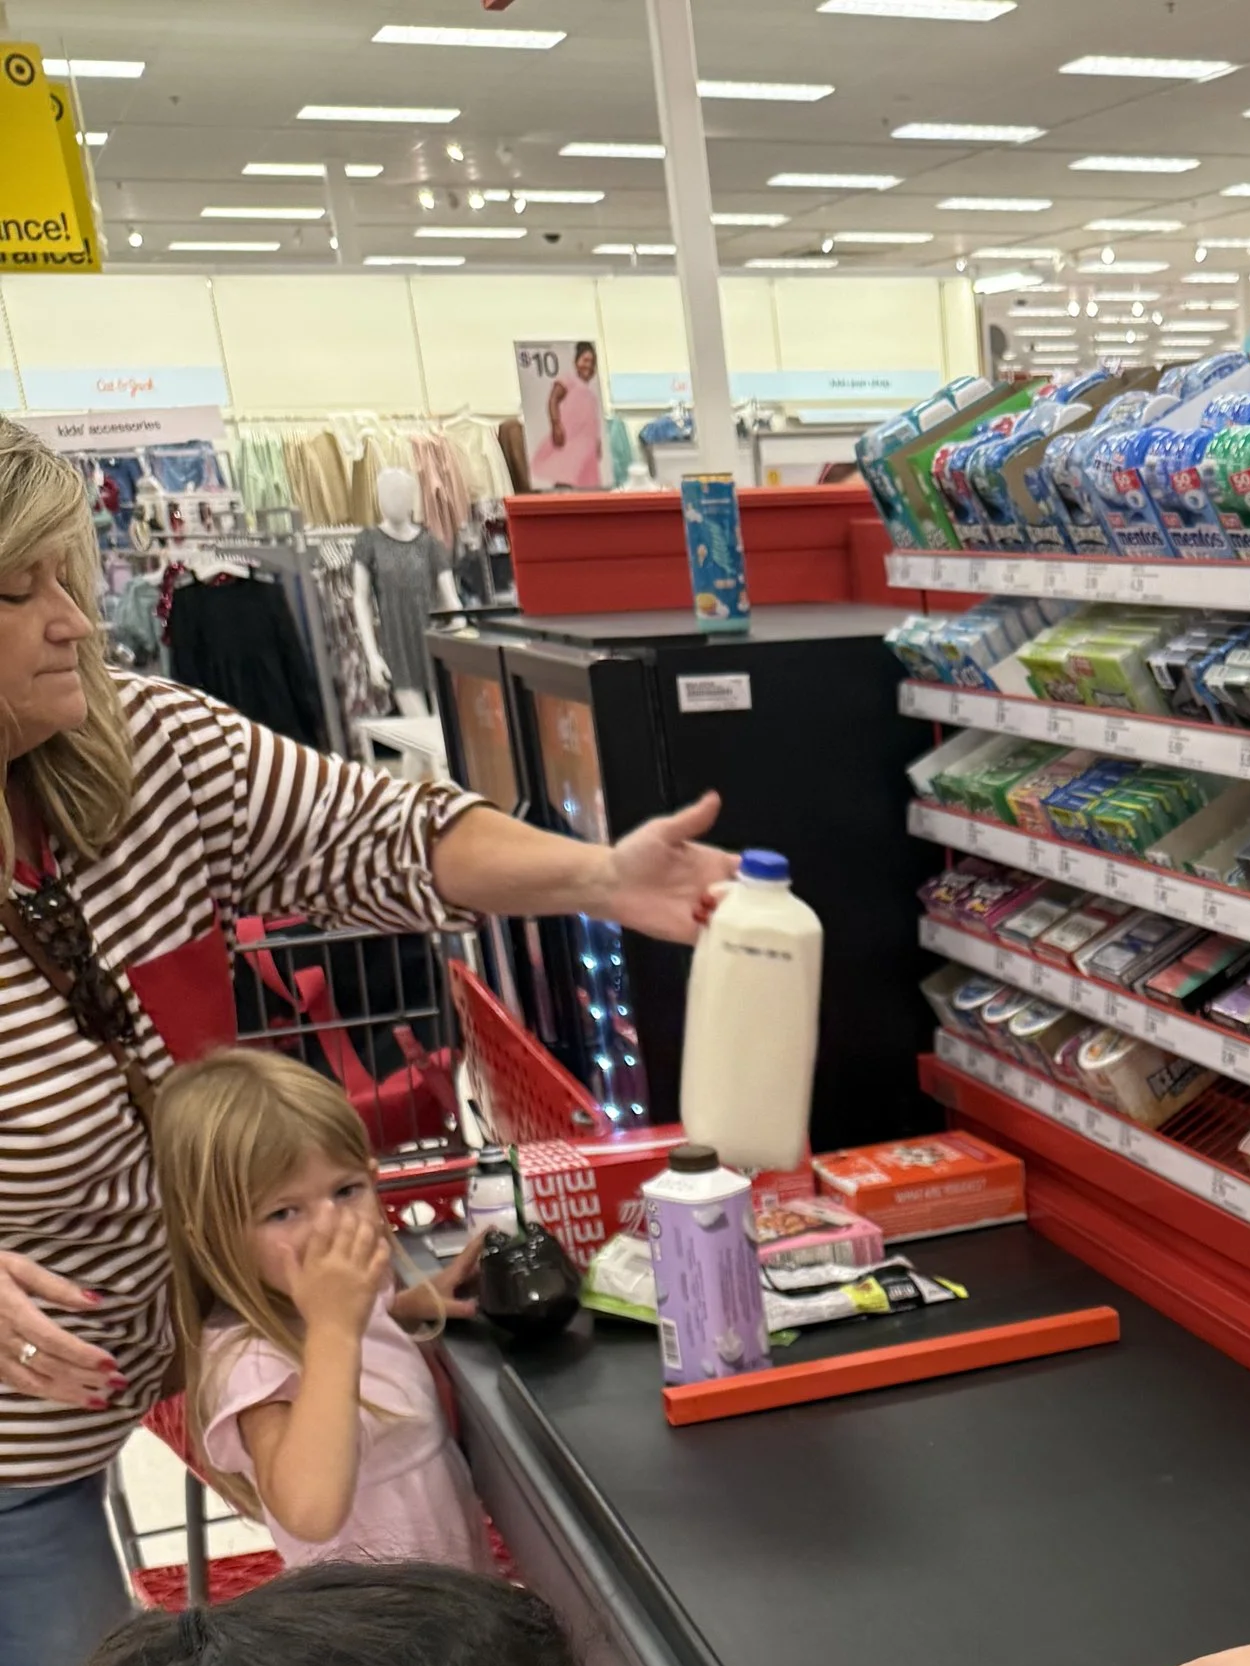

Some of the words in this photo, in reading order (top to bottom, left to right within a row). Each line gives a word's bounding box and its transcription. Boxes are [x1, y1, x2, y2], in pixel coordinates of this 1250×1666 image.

[519, 351, 559, 378] $10
[1116, 531, 1165, 547] mentos
[1171, 530, 1225, 548] mentos
